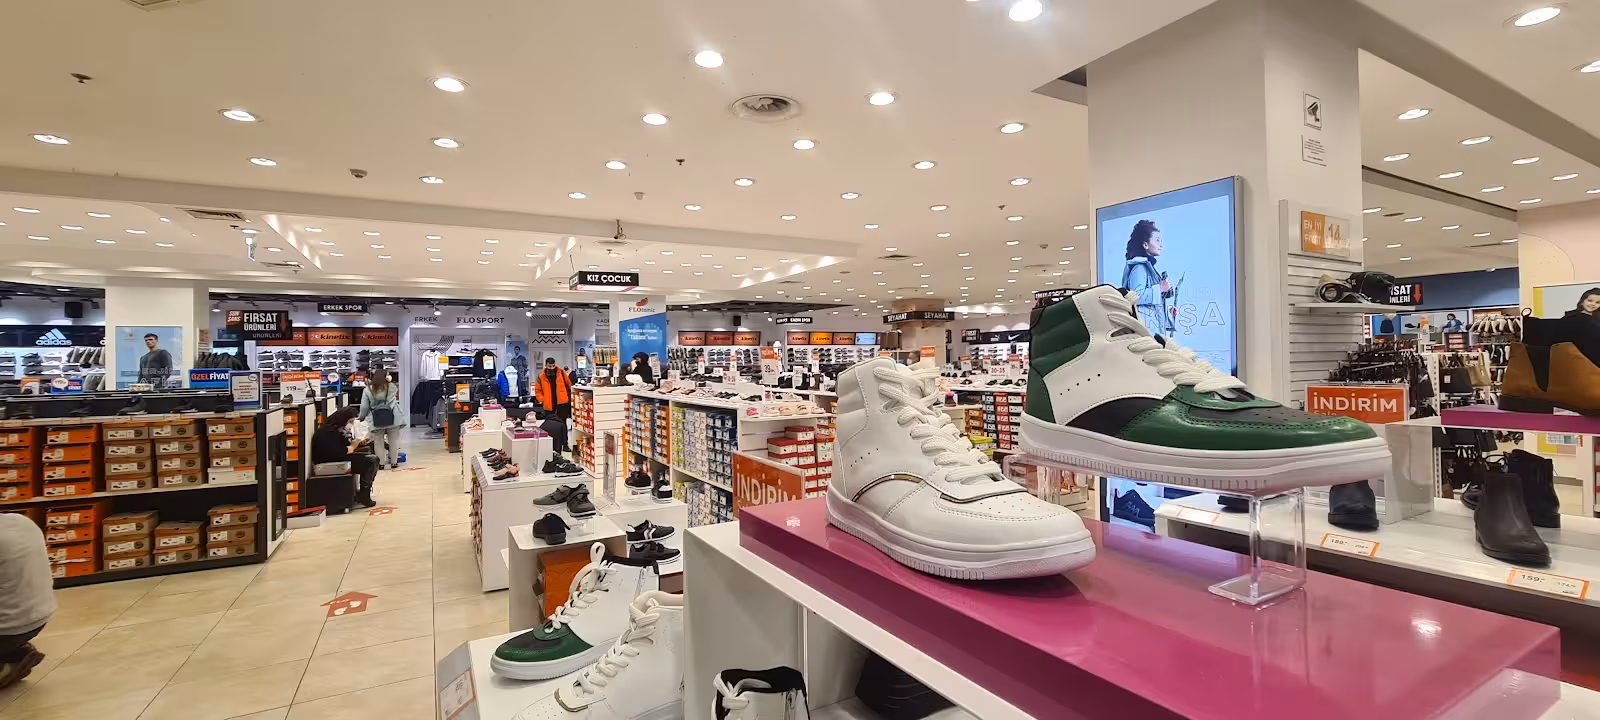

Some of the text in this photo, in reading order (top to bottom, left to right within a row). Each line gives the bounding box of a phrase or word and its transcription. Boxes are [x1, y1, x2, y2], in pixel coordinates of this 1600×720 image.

[586, 274, 599, 282] KIZ
[601, 275, 631, 283] ÇOCUK
[243, 312, 278, 323] FIRSAT
[887, 313, 908, 322] SEYAHAT
[243, 323, 277, 331] ÜRÜNLERİ
[191, 372, 230, 381] ÖZEL FİYAT
[1313, 391, 1398, 412] İNDİRİM
